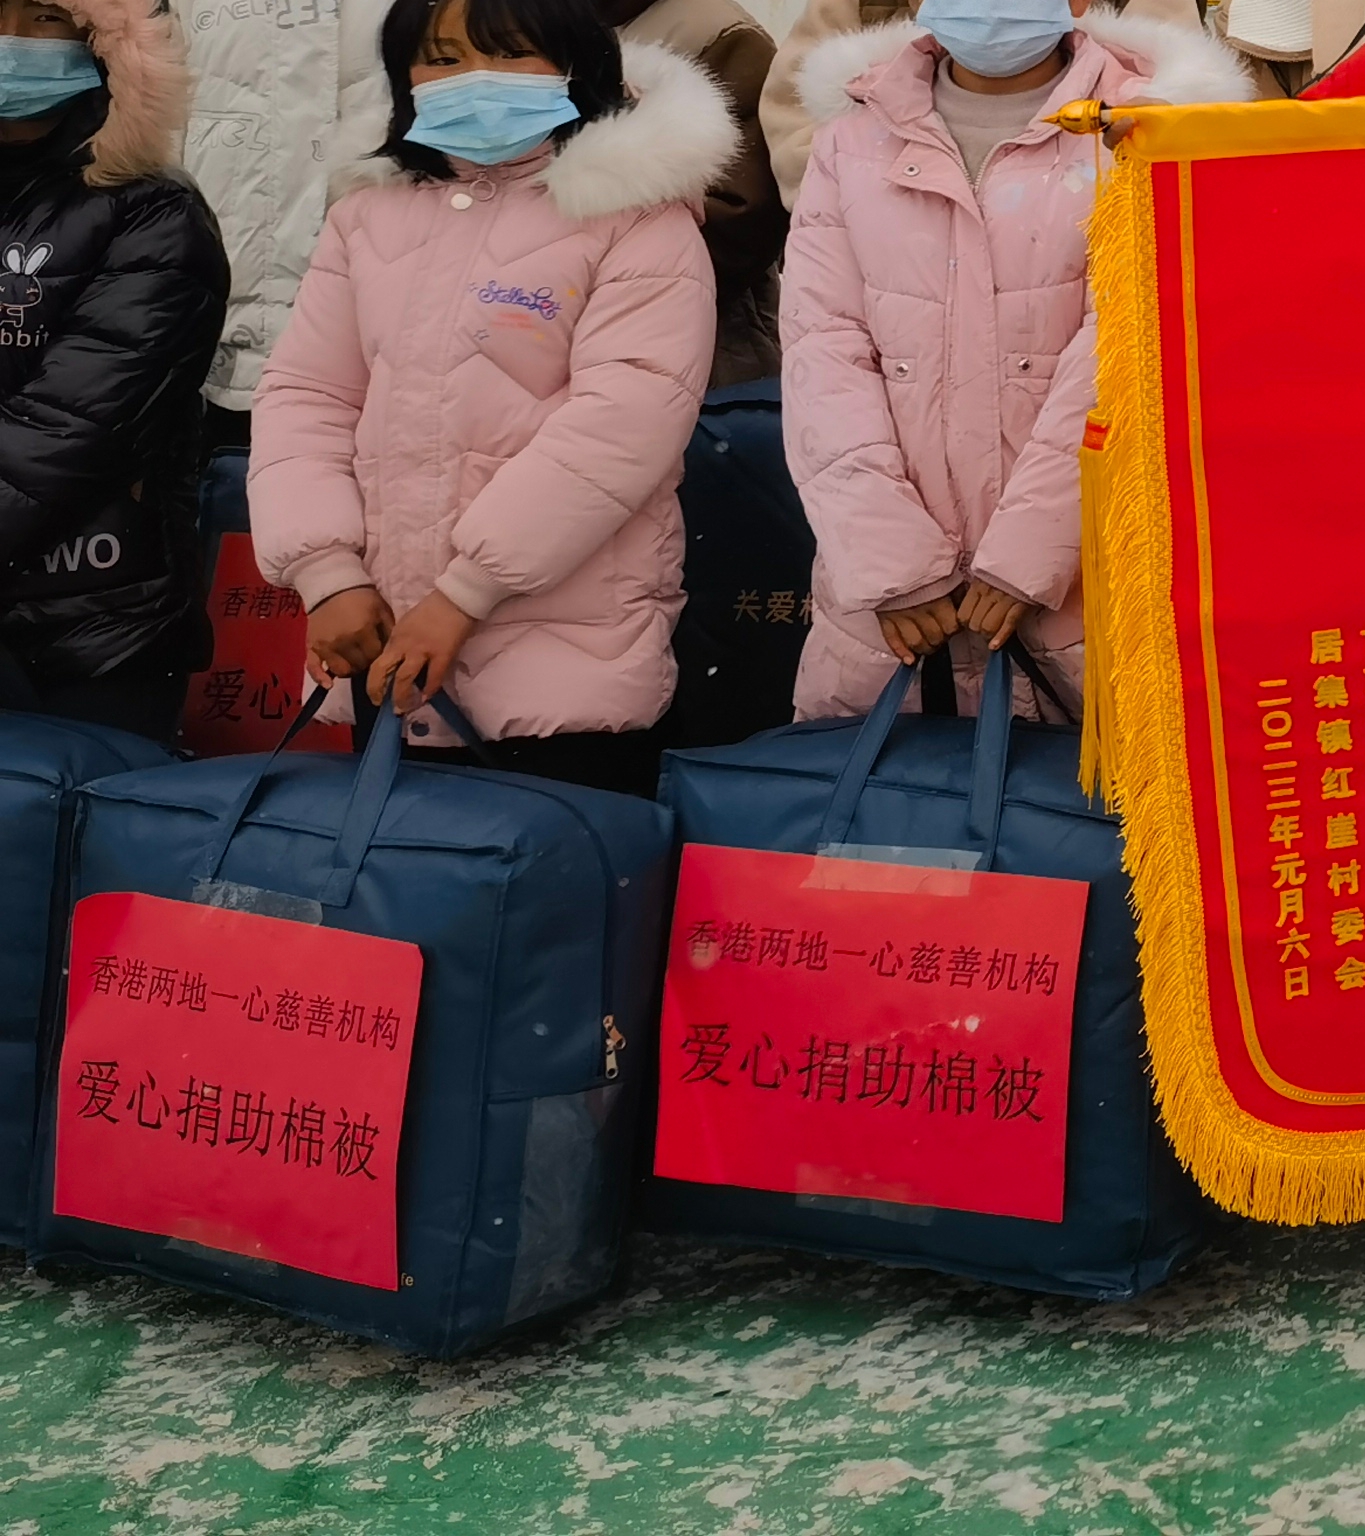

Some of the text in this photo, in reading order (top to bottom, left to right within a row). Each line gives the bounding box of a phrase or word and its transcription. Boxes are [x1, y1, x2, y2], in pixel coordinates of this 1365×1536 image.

[202, 668, 302, 722] 爱心
[88, 954, 402, 1052] 香港两地一心慈善机构
[687, 919, 1060, 997] 香港两地一心慈善机构
[75, 1060, 380, 1182] 爱心捐助棉被
[680, 1023, 1045, 1124] 爱心捐助棉被
